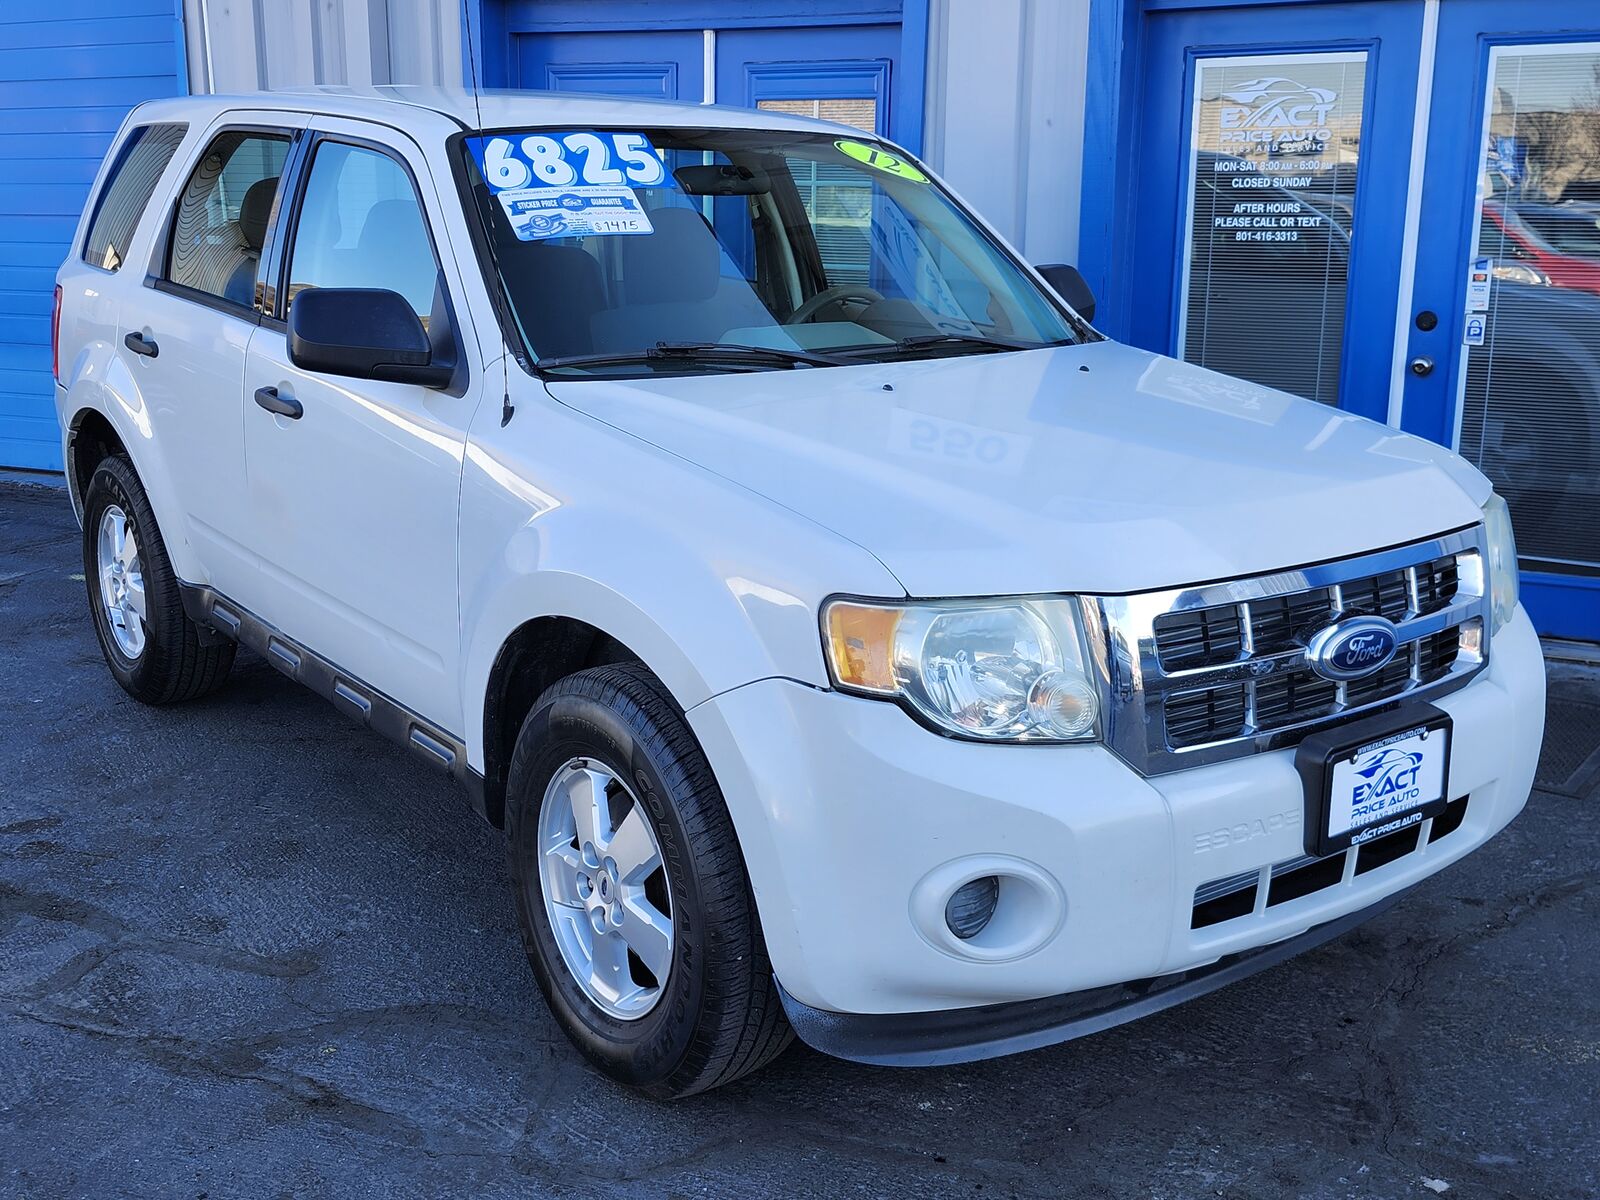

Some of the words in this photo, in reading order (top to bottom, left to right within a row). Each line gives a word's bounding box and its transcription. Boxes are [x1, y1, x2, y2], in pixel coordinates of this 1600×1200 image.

[1220, 102, 1335, 128] EXACT
[1220, 130, 1273, 142] PRICE
[1276, 128, 1333, 141] AUTO
[1256, 143, 1279, 152] AND
[483, 133, 665, 189] 6825
[867, 150, 901, 173] 12
[1214, 161, 1258, 172] MON-SAT
[1299, 160, 1320, 170] 6:00
[1231, 178, 1271, 188] CLOSED
[1272, 177, 1312, 187] SUNDAY
[516, 200, 541, 210] STICKER
[540, 199, 559, 208] PRICE
[1233, 204, 1265, 213] AFTER
[1266, 203, 1301, 213] HOURS
[1214, 217, 1251, 227] PLEASE
[1252, 217, 1278, 227] CALL
[1280, 217, 1295, 227] OR
[1297, 217, 1322, 227] TEXT
[1235, 231, 1298, 241] 801-416-3313
[1346, 634, 1384, 665] Ford
[1352, 764, 1421, 806] EXACT
[1351, 799, 1386, 819] PRICE
[1388, 788, 1420, 807] AUTO
[1193, 808, 1300, 855] ESCAPE
[1351, 828, 1378, 845] EXACT
[1377, 820, 1401, 835] PRICE
[1400, 812, 1423, 826] AUTO
